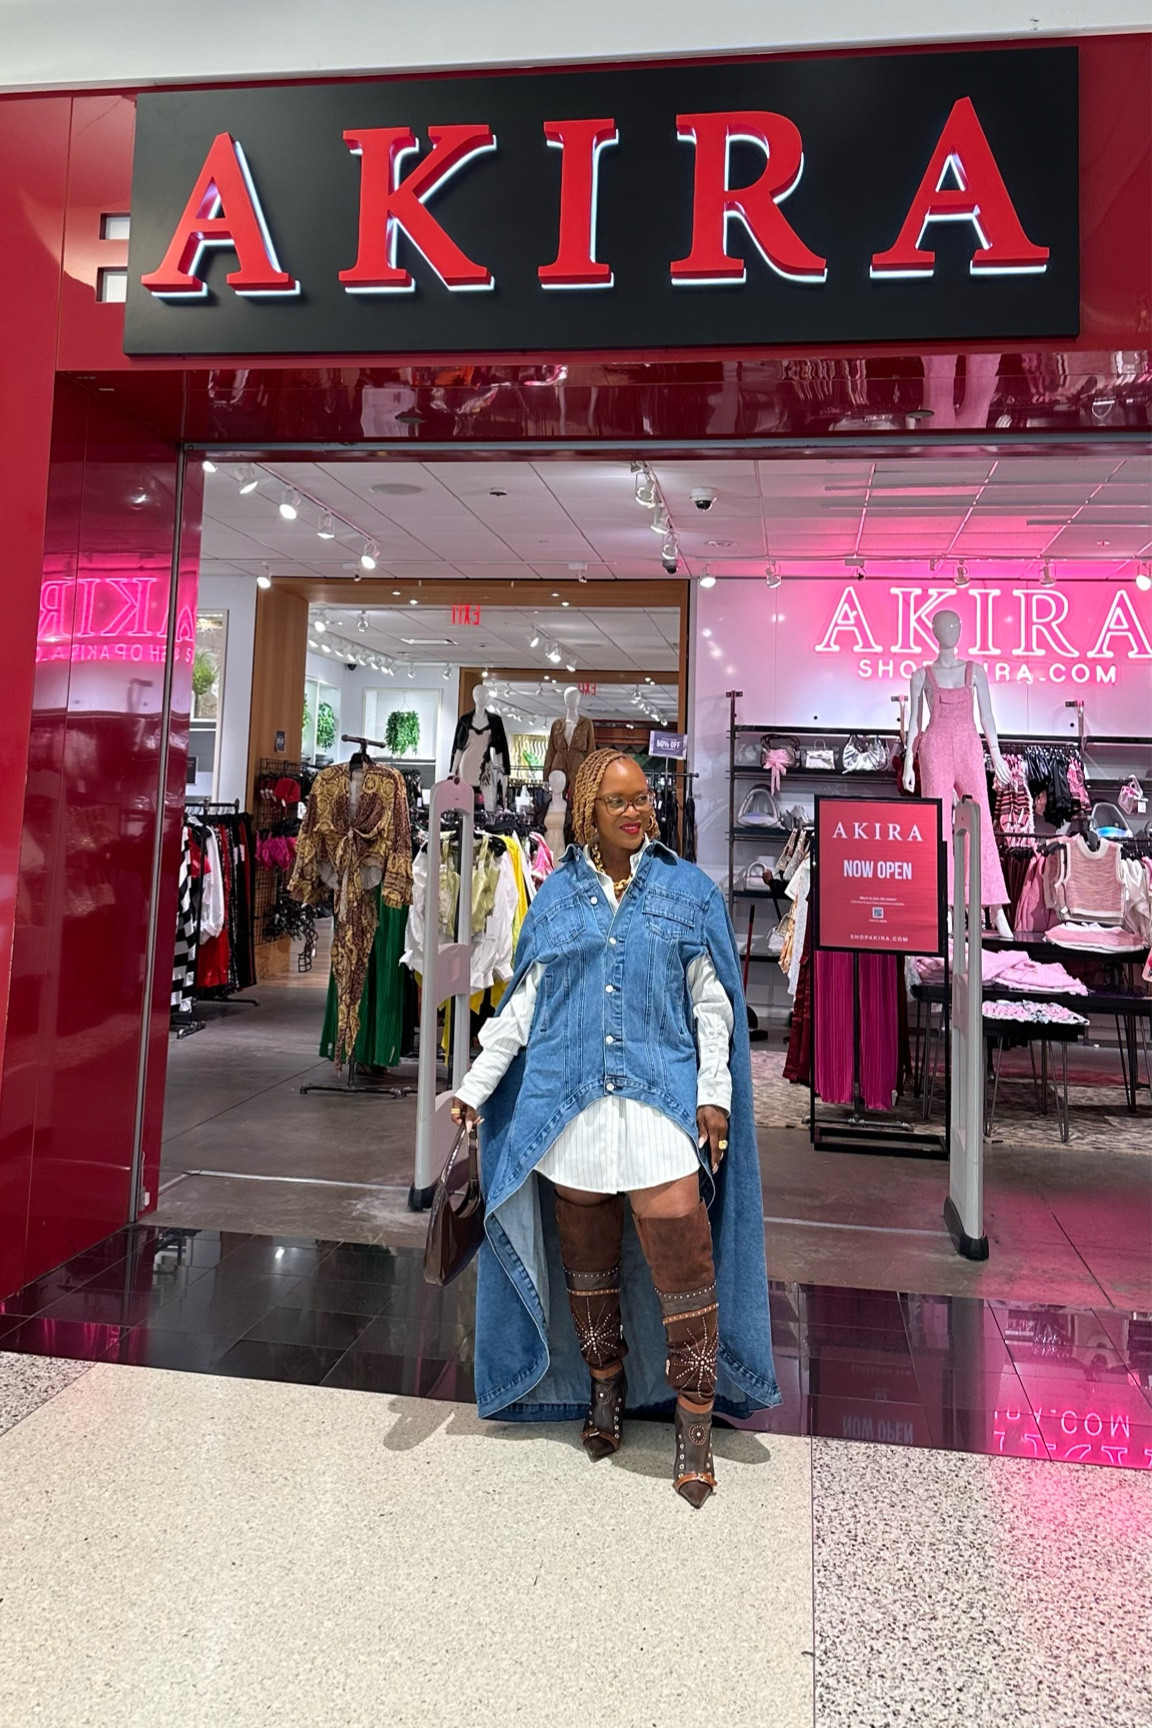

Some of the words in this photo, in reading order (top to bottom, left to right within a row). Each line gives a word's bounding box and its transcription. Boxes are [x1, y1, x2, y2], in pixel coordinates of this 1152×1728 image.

[142, 97, 1050, 297] AKIRA
[815, 586, 1152, 659] AKIRA
[670, 741, 681, 749] OFF
[832, 821, 924, 842] AKIRA
[843, 860, 874, 878] NOW
[877, 861, 912, 880] OPEN
